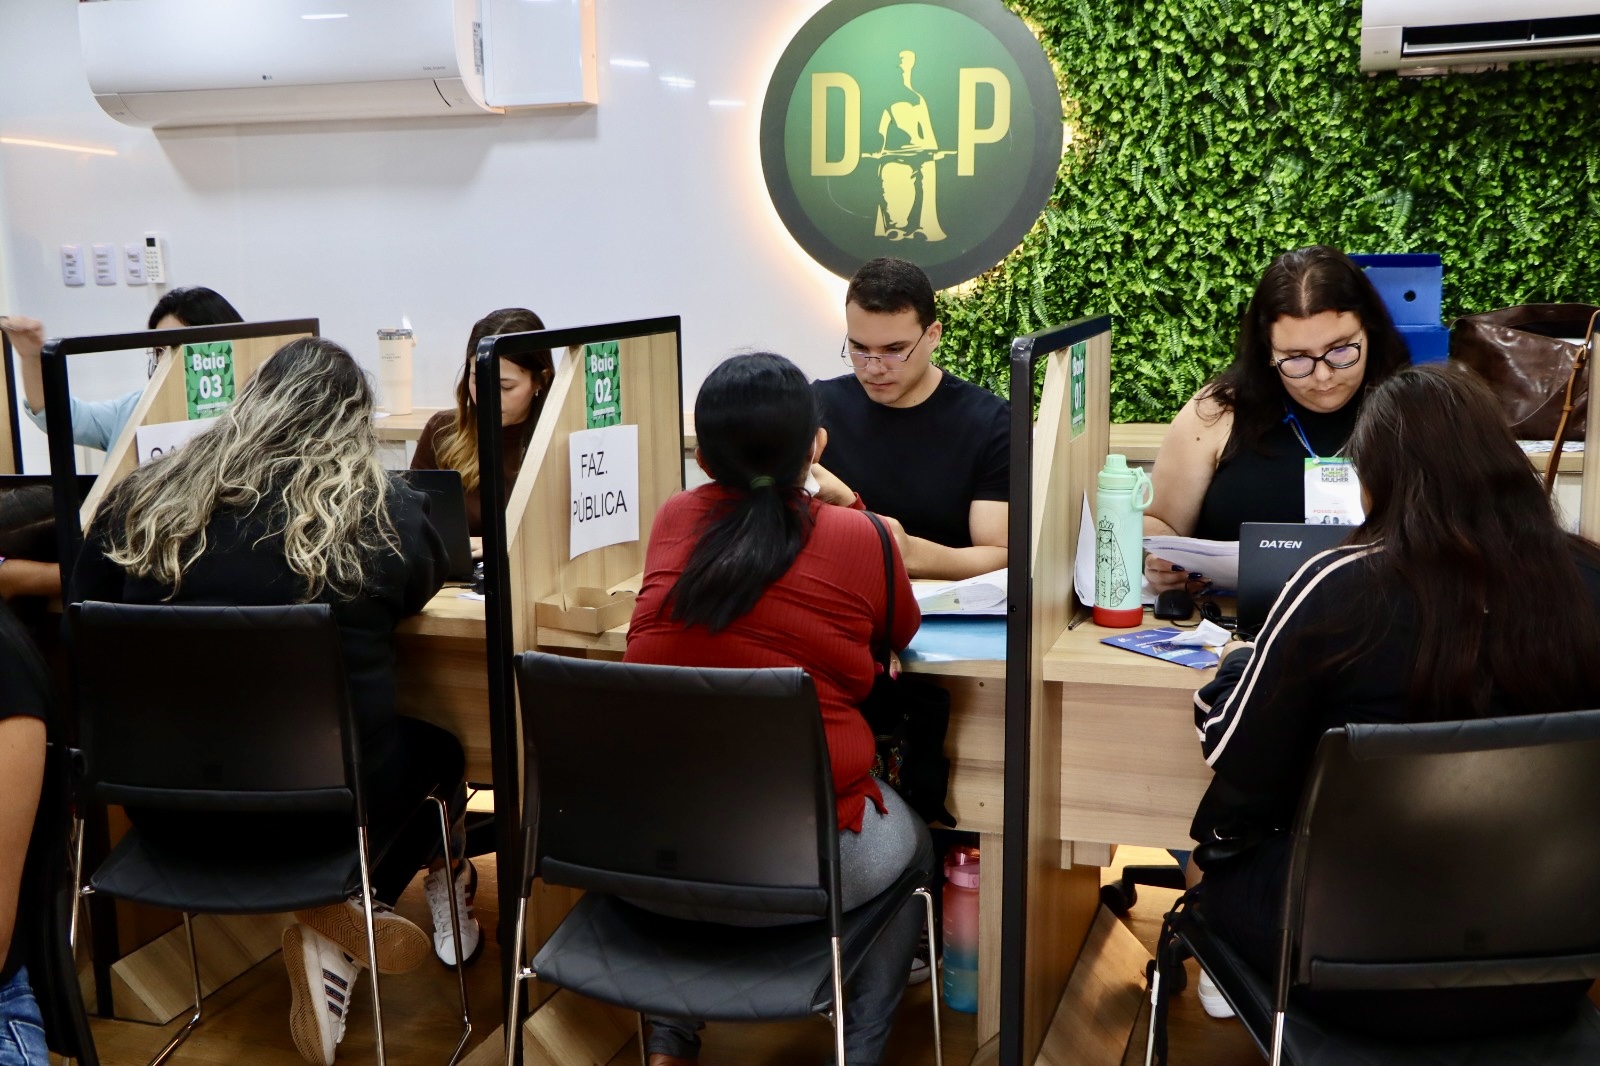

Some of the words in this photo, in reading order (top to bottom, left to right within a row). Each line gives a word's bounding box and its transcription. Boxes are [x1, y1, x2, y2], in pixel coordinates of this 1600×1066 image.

[811, 72, 860, 176] D
[957, 67, 1011, 176] P
[193, 352, 225, 371] Baia
[590, 352, 614, 373] Baia
[199, 374, 223, 399] 03
[595, 377, 612, 404] 02
[1074, 381, 1082, 410] 01
[581, 451, 608, 479] FAZ.
[573, 490, 628, 525] PÚBLICA
[1259, 540, 1303, 549] DATEN
